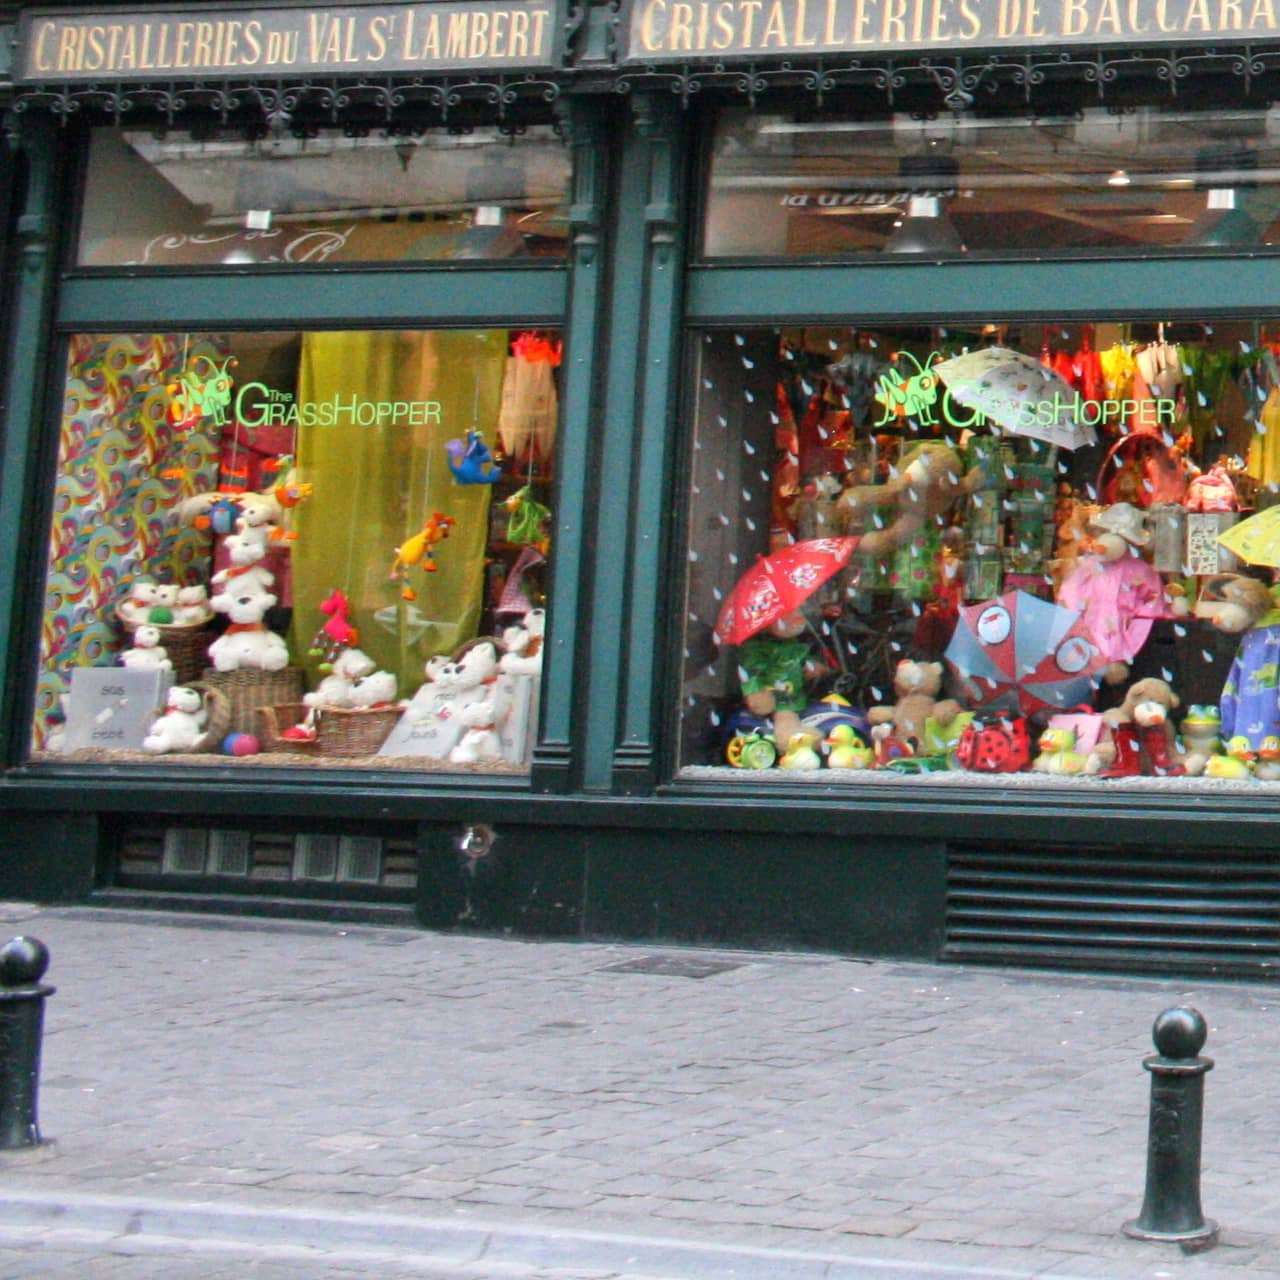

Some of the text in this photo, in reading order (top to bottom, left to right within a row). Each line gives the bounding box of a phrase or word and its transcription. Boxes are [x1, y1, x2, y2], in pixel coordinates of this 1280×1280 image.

[34, 19, 262, 73] CRISTALLERIES
[264, 31, 299, 65] DU
[309, 13, 359, 64] VAL
[402, 9, 549, 61] LAMBERT
[270, 389, 293, 404] The
